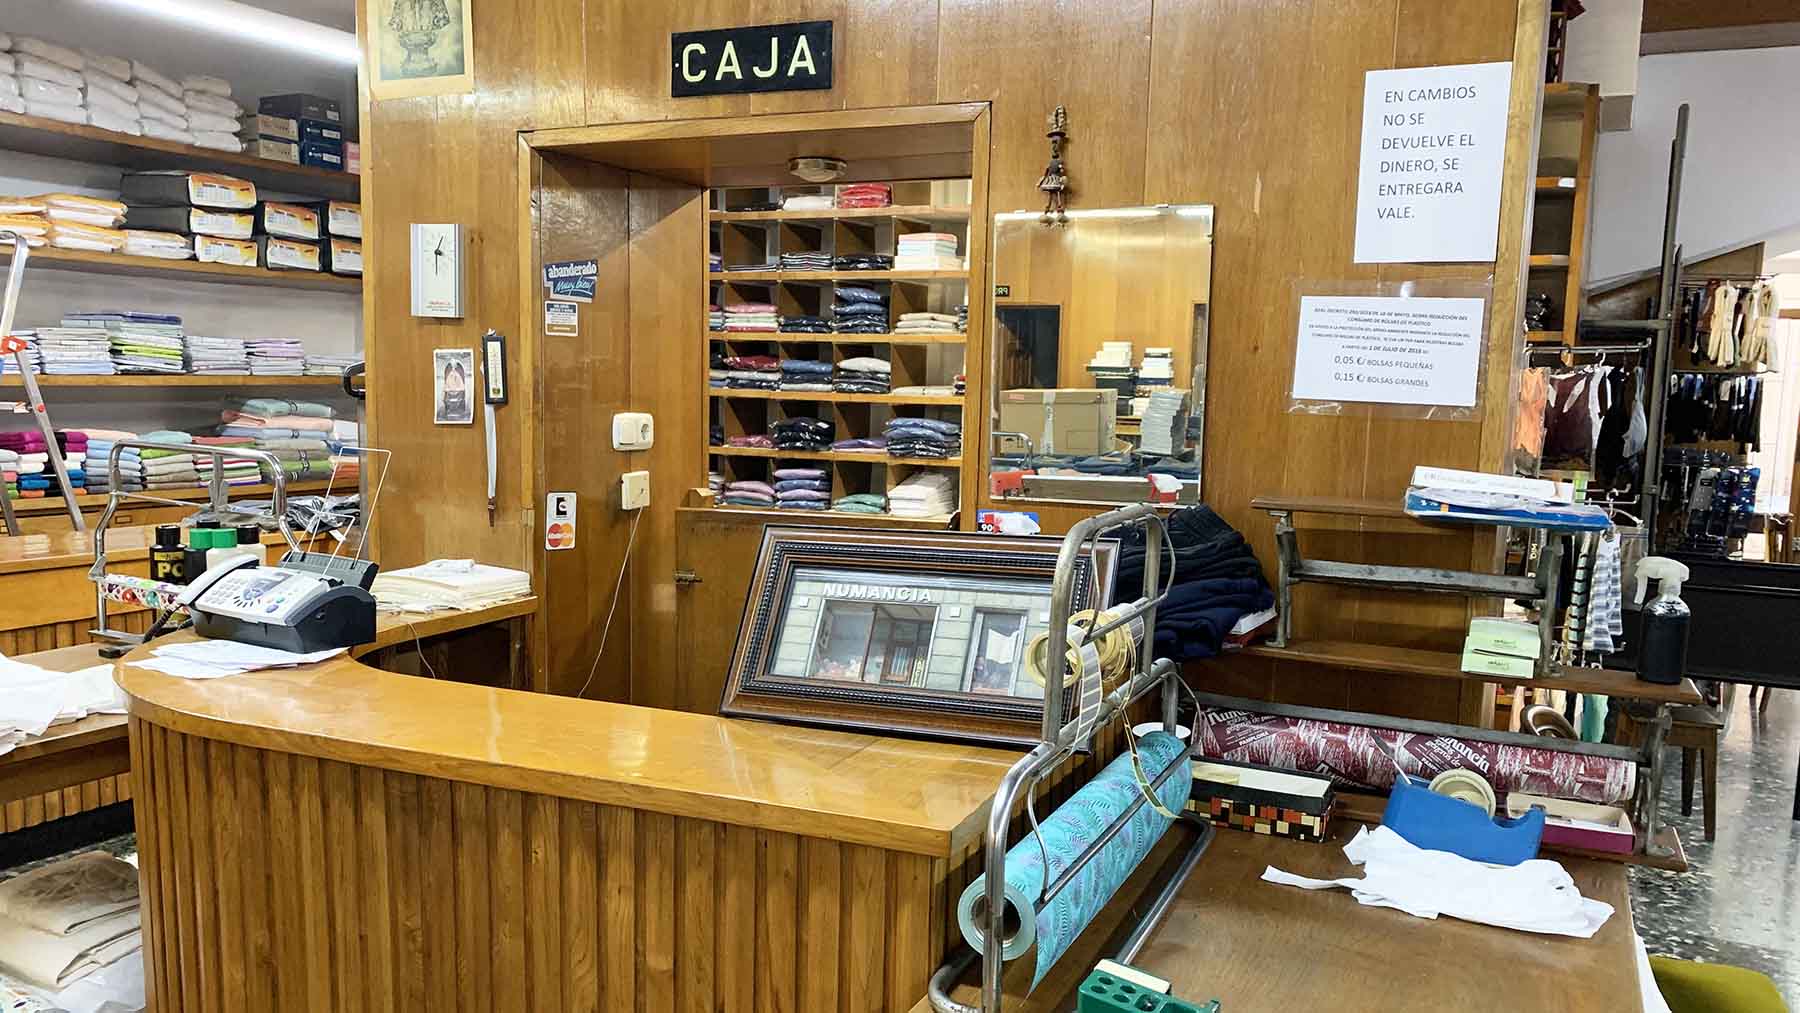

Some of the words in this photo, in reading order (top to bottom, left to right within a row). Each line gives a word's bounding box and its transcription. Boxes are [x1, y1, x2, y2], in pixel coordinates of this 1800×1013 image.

[682, 34, 817, 82] CAJA
[1385, 90, 1404, 103] EN
[1408, 86, 1477, 102] CAMBIOS
[1383, 113, 1405, 126] NO
[1409, 112, 1425, 125] SE
[1381, 134, 1455, 150] DEVUELVE
[1459, 134, 1476, 146] EL
[1380, 158, 1439, 174] DINERO,
[1442, 158, 1460, 170] SE
[1378, 181, 1464, 196] ENTREGARA
[1377, 206, 1415, 219] VALE.
[548, 261, 597, 279] abanderado
[1367, 359, 1393, 368] BOLSAS
[1367, 376, 1393, 385] BOLSAS
[1395, 377, 1430, 388] GRANDES
[823, 582, 931, 603] NUMANCIA
